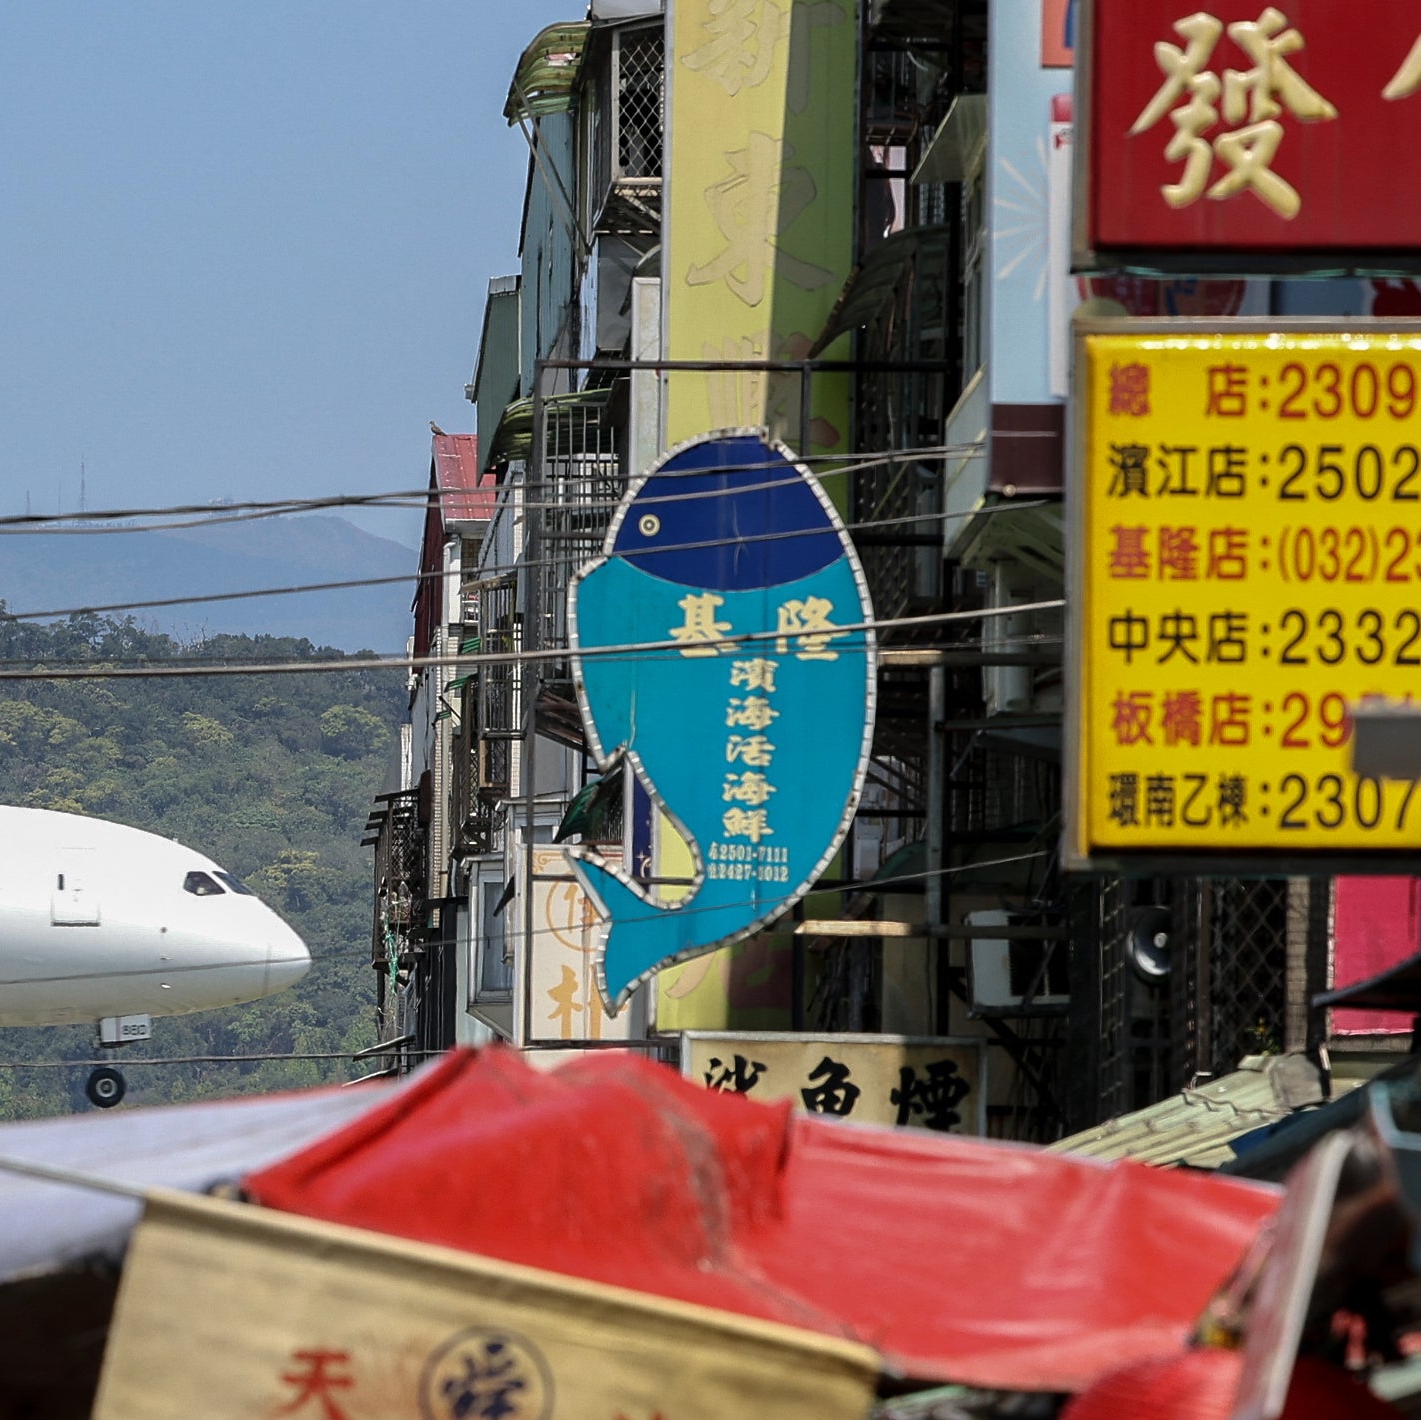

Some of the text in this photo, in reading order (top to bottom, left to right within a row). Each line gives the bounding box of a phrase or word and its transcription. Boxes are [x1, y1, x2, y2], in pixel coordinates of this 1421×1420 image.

[1109, 525, 1421, 583] 基隆店:(032)2
[669, 592, 851, 662] 基隆
[721, 657, 781, 843] 濱海活海鮮
[1110, 689, 1415, 750] 板橋店:29
